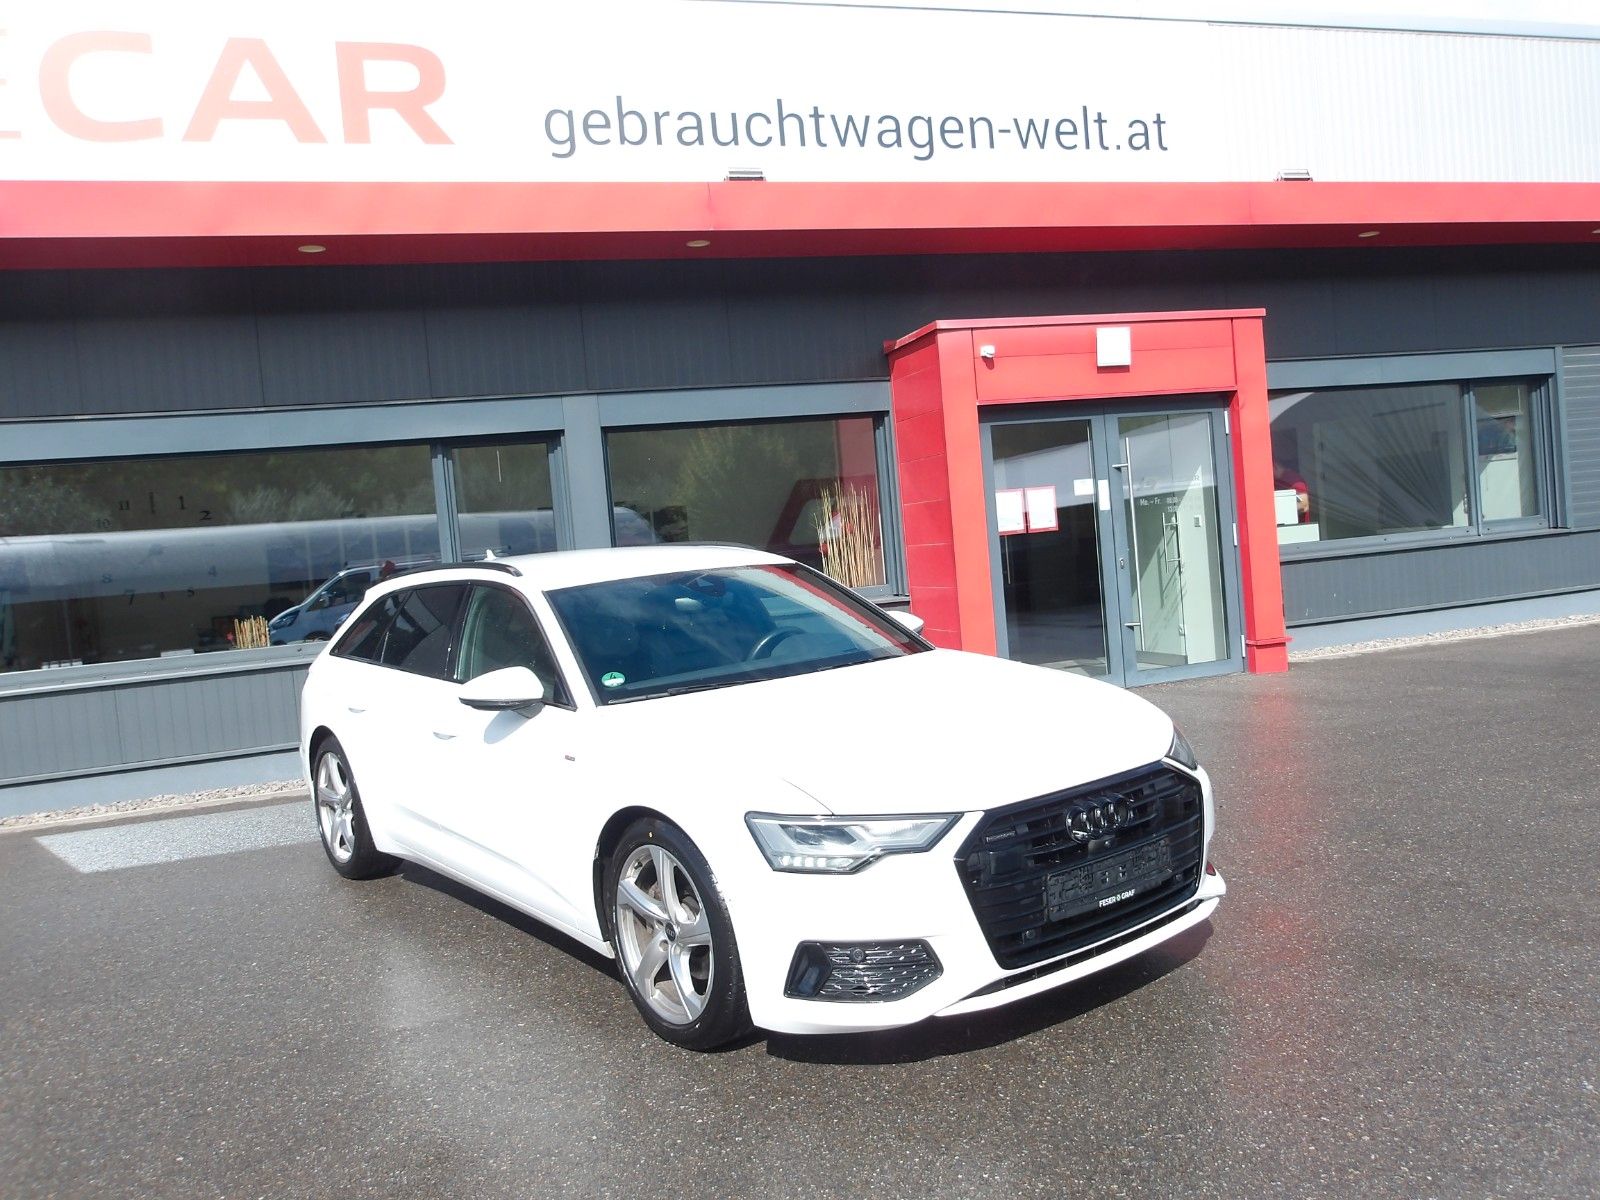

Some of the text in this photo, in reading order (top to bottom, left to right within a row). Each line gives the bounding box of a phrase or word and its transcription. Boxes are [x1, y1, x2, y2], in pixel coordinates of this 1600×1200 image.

[0, 30, 456, 145] CAR
[544, 95, 1168, 161] gebrauchtwagen-welt.at
[1099, 896, 1116, 907] FESER
